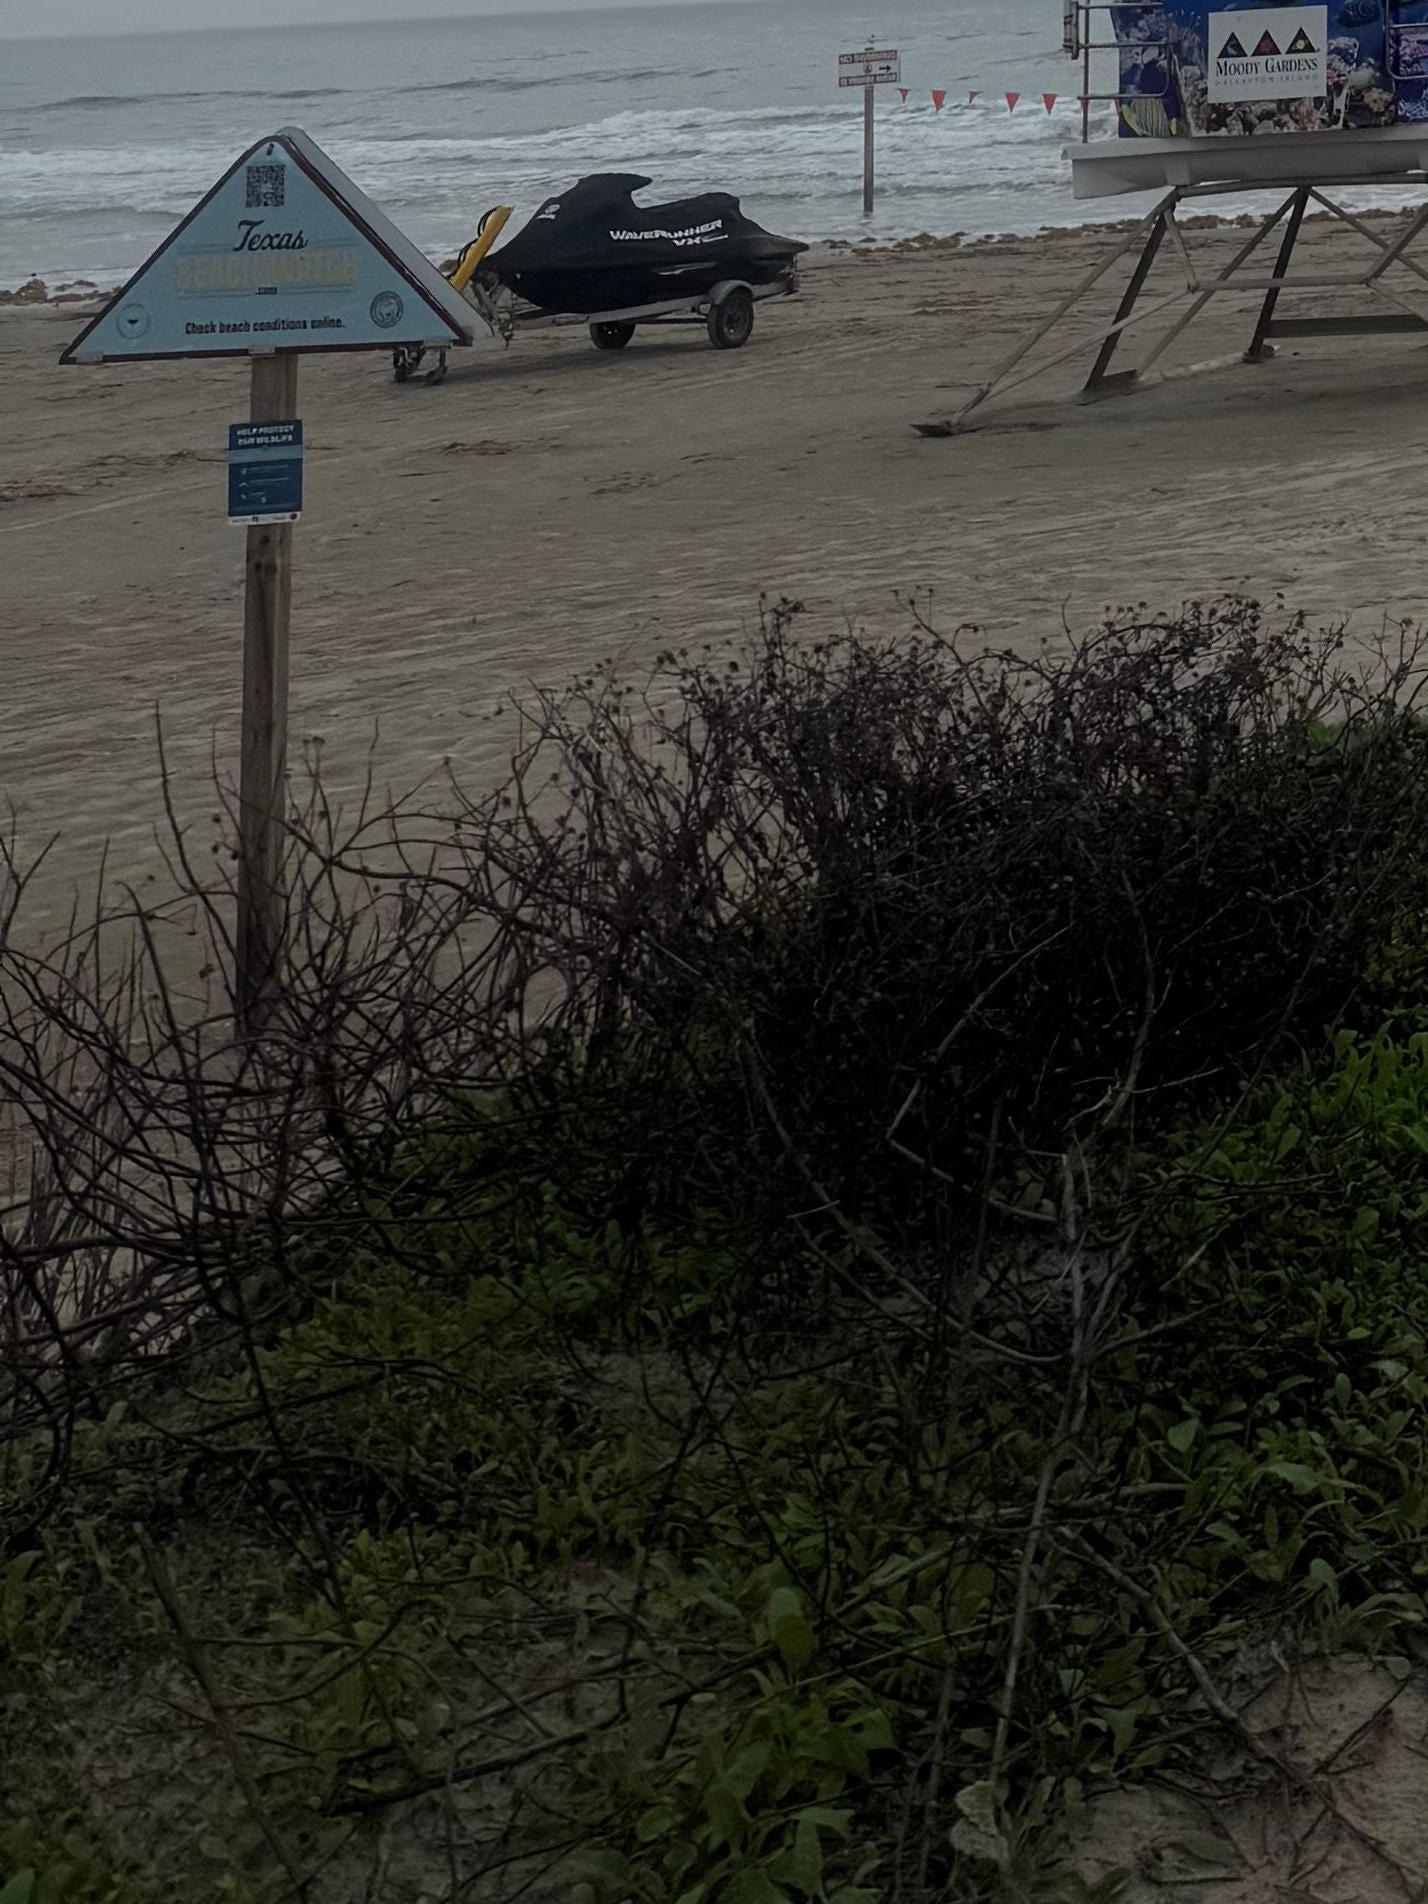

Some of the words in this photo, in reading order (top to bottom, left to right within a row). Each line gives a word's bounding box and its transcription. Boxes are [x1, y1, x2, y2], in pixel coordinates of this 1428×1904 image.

[1216, 60, 1260, 78] MOODY
[1265, 57, 1319, 73] GARDENS
[233, 219, 309, 252] Texas
[610, 219, 722, 241] WAVERUNNER
[185, 321, 216, 335] Check
[218, 320, 251, 334] beach
